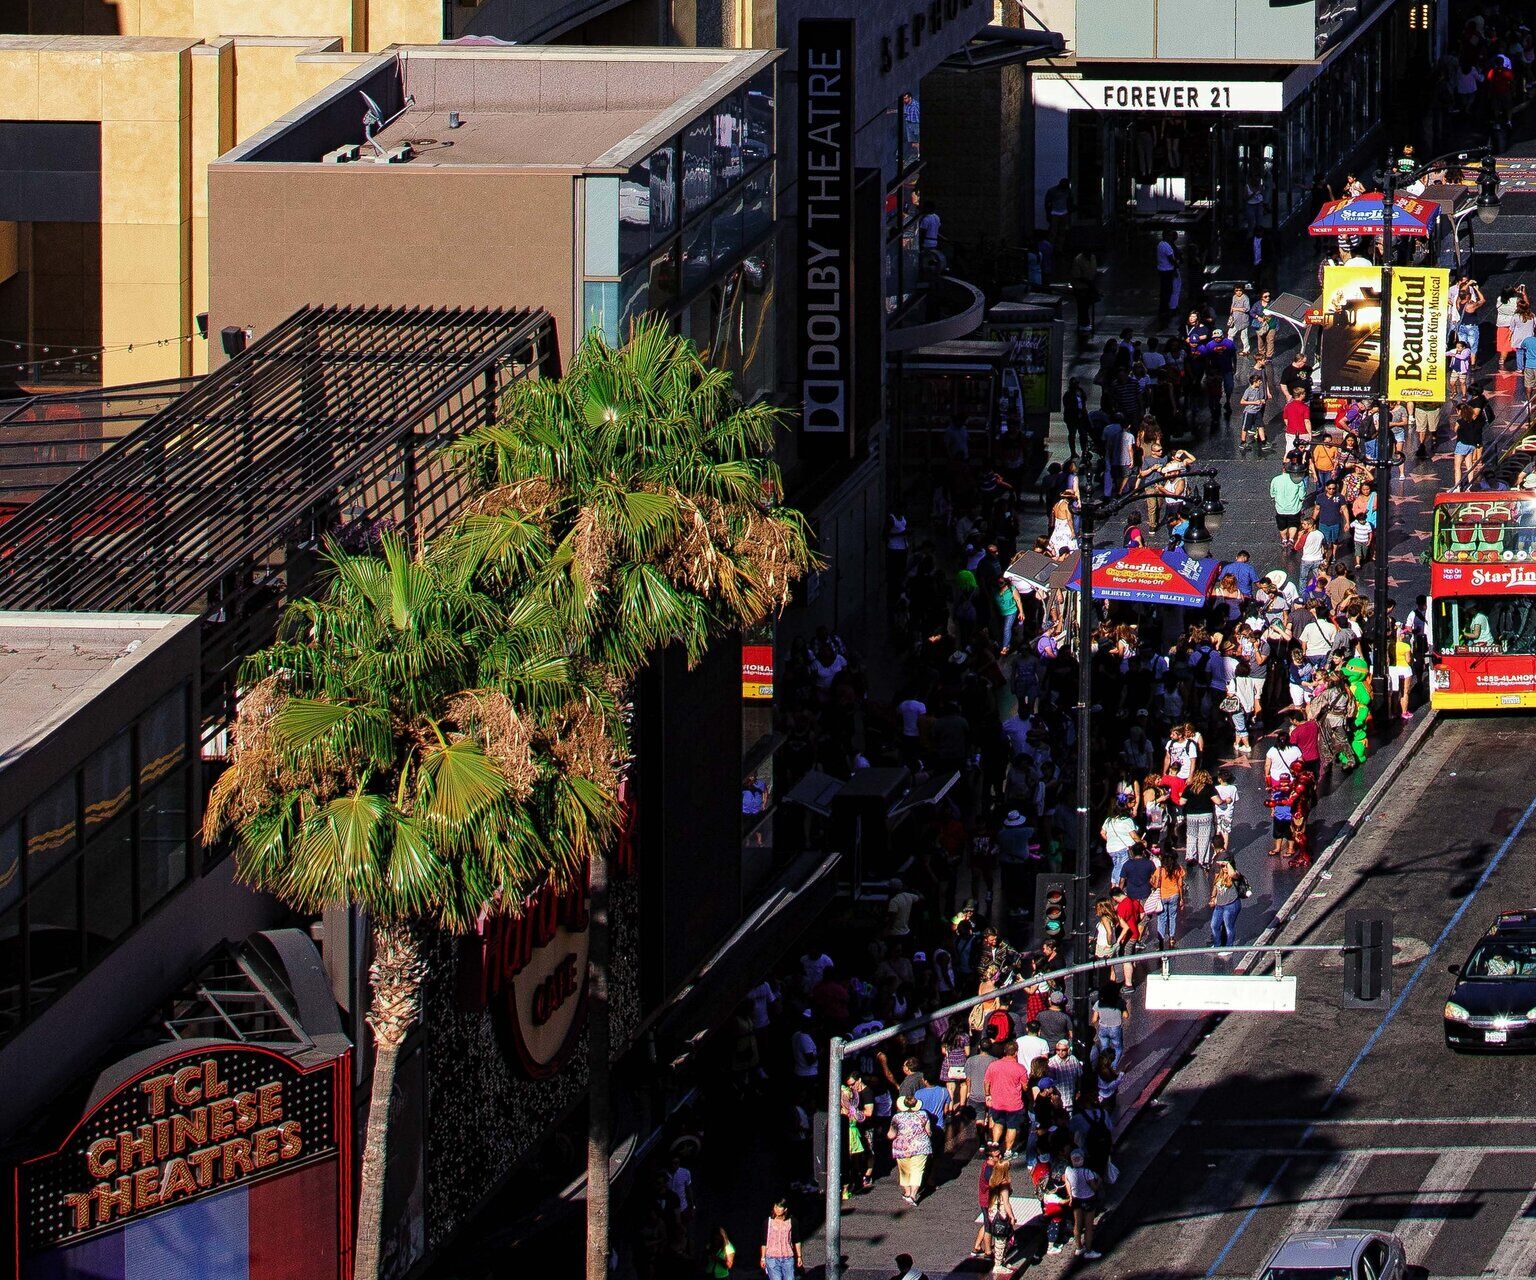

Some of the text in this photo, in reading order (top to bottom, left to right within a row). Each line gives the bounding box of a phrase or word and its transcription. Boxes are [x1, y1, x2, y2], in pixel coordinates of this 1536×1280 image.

[1103, 86, 1231, 108] FOREVER 21
[806, 48, 841, 371] DOLBY THEATRE
[1341, 208, 1401, 220] StarLie
[1396, 276, 1426, 382] Beautiful
[1427, 276, 1443, 381] The Carole King Musical
[1112, 576, 1164, 586] Hop On Hop Off
[1114, 560, 1165, 572] StarLine
[532, 952, 578, 1026] CAFE
[141, 1057, 229, 1118] TCL
[86, 1079, 284, 1180] CHINESE
[63, 1119, 303, 1234] THEATRES
